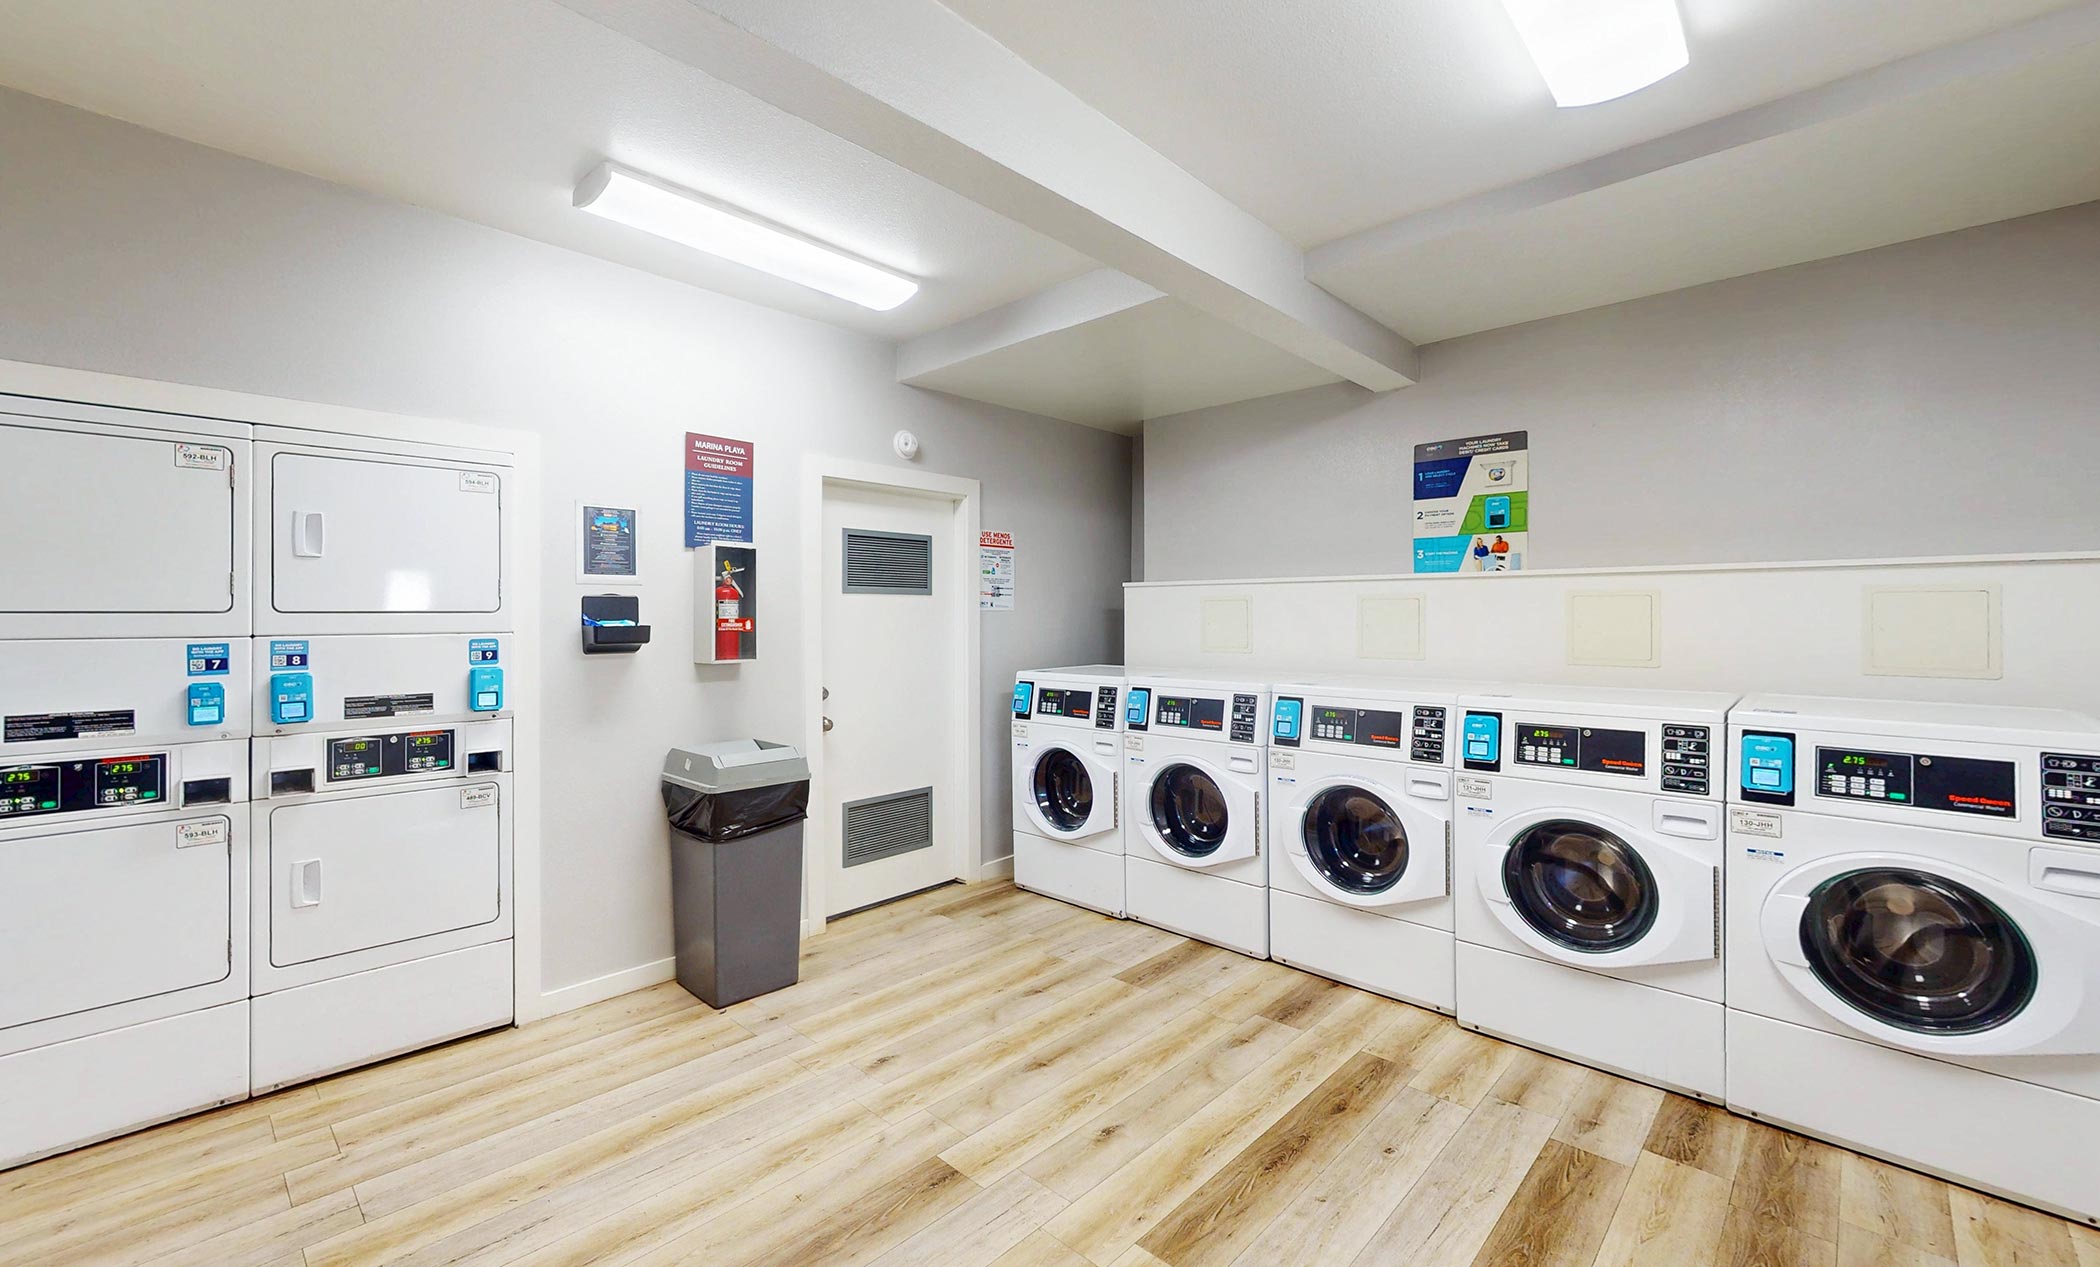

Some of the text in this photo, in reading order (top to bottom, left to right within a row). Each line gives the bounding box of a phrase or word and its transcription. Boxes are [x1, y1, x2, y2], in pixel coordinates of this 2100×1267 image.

[694, 440, 746, 455] MARINA PLAYA
[182, 453, 218, 461] 592-BLH
[696, 455, 743, 467] LAUNDRY ROOM
[703, 462, 737, 472] GUIDELINES
[1418, 472, 1423, 482] 1
[1417, 511, 1424, 520] 2
[993, 532, 1010, 540] MENOS
[980, 537, 1012, 546] DETERGENTE
[1417, 550, 1424, 559] 3
[292, 655, 301, 665] 8
[485, 651, 493, 660] 9
[211, 659, 221, 670] 7
[1948, 794, 2011, 807] Speed Queen
[1953, 801, 1984, 809] Commercial
[1740, 819, 1773, 828] 130-JHH
[184, 829, 218, 839] 593-BLH
